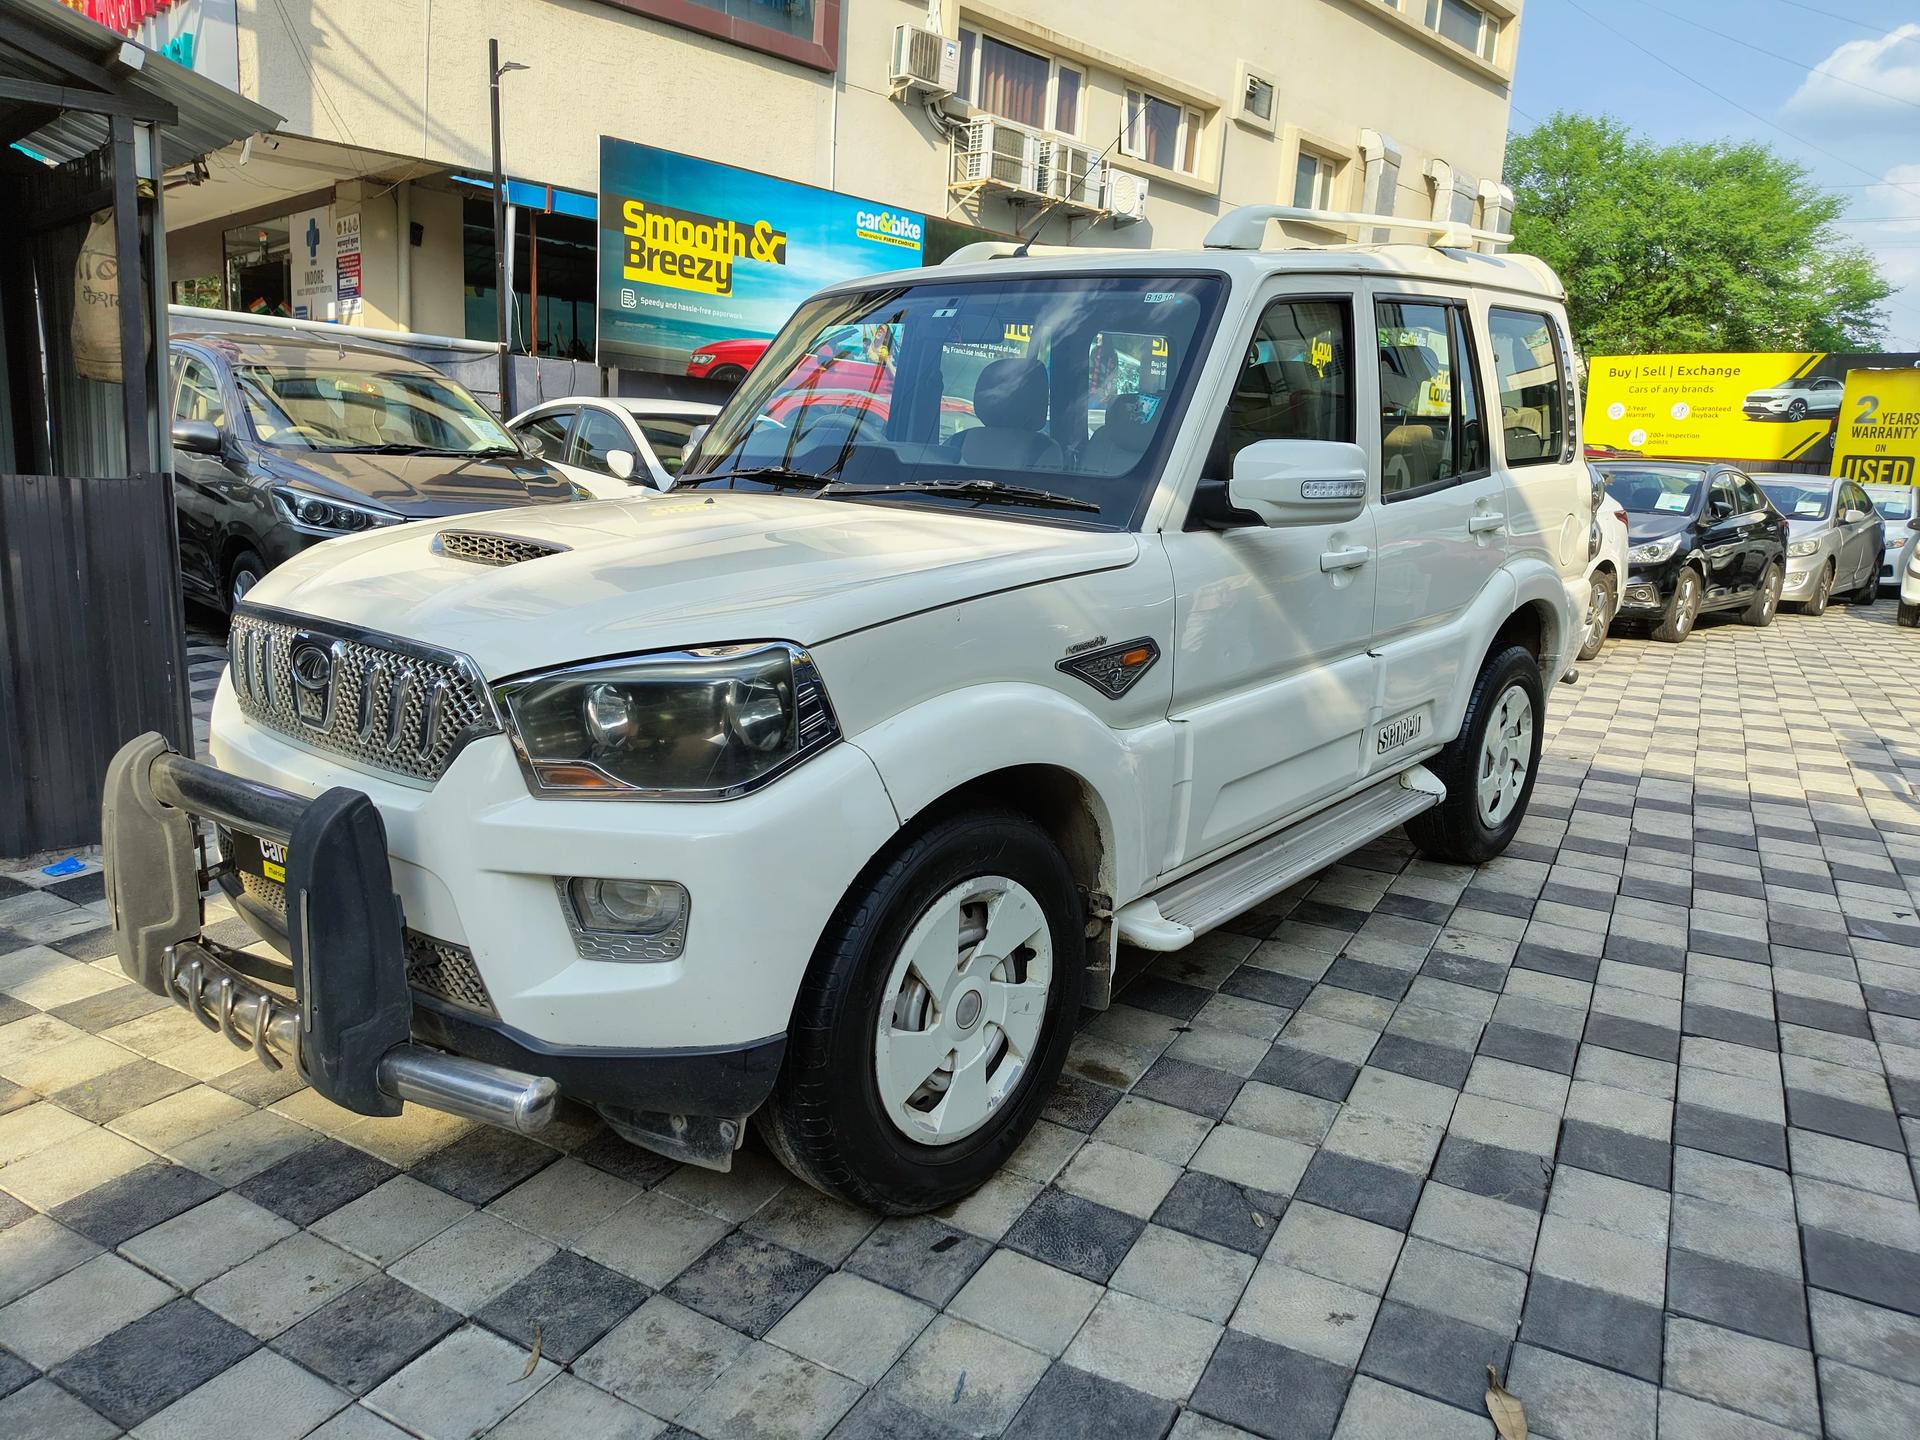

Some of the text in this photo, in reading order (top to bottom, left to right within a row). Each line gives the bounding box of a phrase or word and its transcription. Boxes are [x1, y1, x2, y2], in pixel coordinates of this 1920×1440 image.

[623, 200, 787, 264] Smooth &
[856, 211, 921, 240] car&bike
[624, 235, 732, 294] Breezy
[304, 269, 324, 286] INDORE
[640, 296, 743, 320] Speedy and hassle-free paperwork
[942, 345, 950, 354] By
[1609, 367, 1631, 379] Buy
[1643, 366, 1666, 377] Sell
[1677, 365, 1741, 378] Exchange
[1628, 384, 1715, 395] Cars of any brands
[1626, 411, 1656, 419] Warranty
[1691, 411, 1719, 419] Buyback
[1692, 405, 1732, 413] Guaranteed
[1854, 395, 1920, 426] 2 YEARS
[1851, 426, 1918, 440] WARRANTY
[1875, 444, 1886, 453] ON
[1845, 459, 1909, 485] USED
[1377, 712, 1421, 754] SCORPIO
